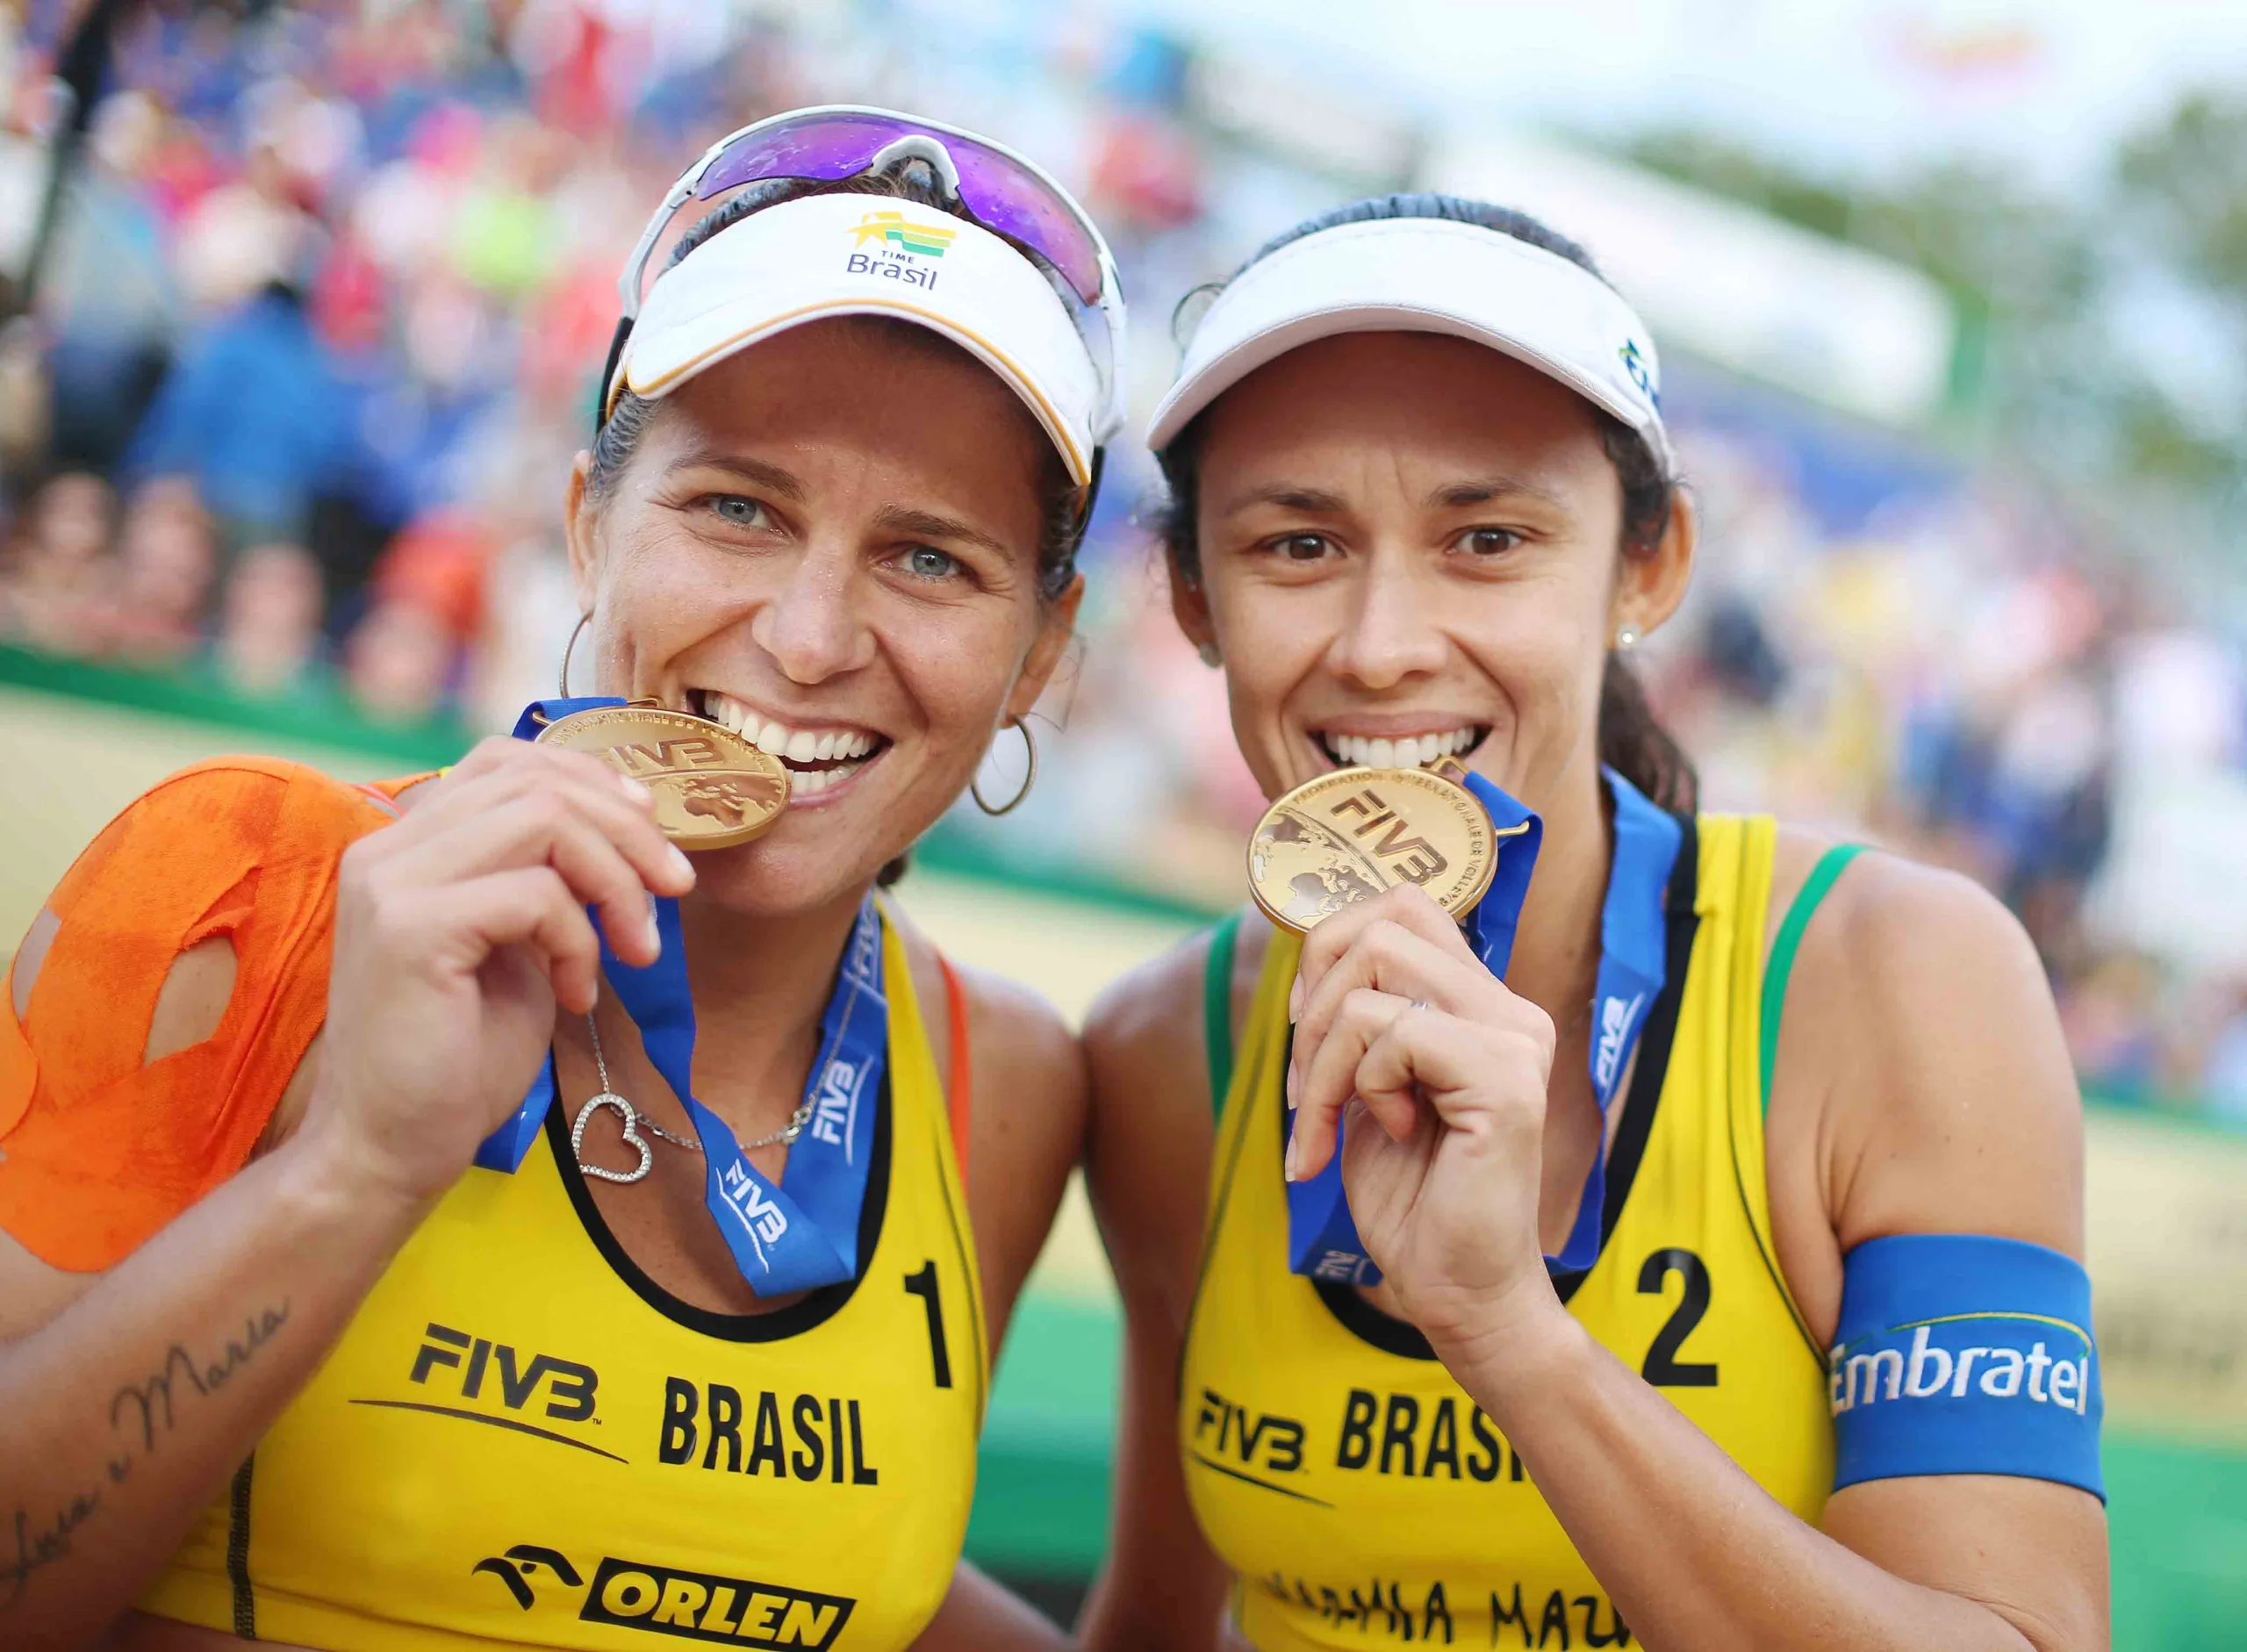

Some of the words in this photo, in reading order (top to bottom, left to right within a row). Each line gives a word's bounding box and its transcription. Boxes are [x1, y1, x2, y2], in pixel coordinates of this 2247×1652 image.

[847, 253, 938, 291] Brasil
[881, 250, 915, 264] TIME
[904, 1259, 953, 1390] 1
[1636, 1247, 1719, 1388] 2
[1829, 1325, 2090, 1418] Embratel
[658, 1375, 879, 1485] BRASIL
[601, 1570, 840, 1648] ORLEN
